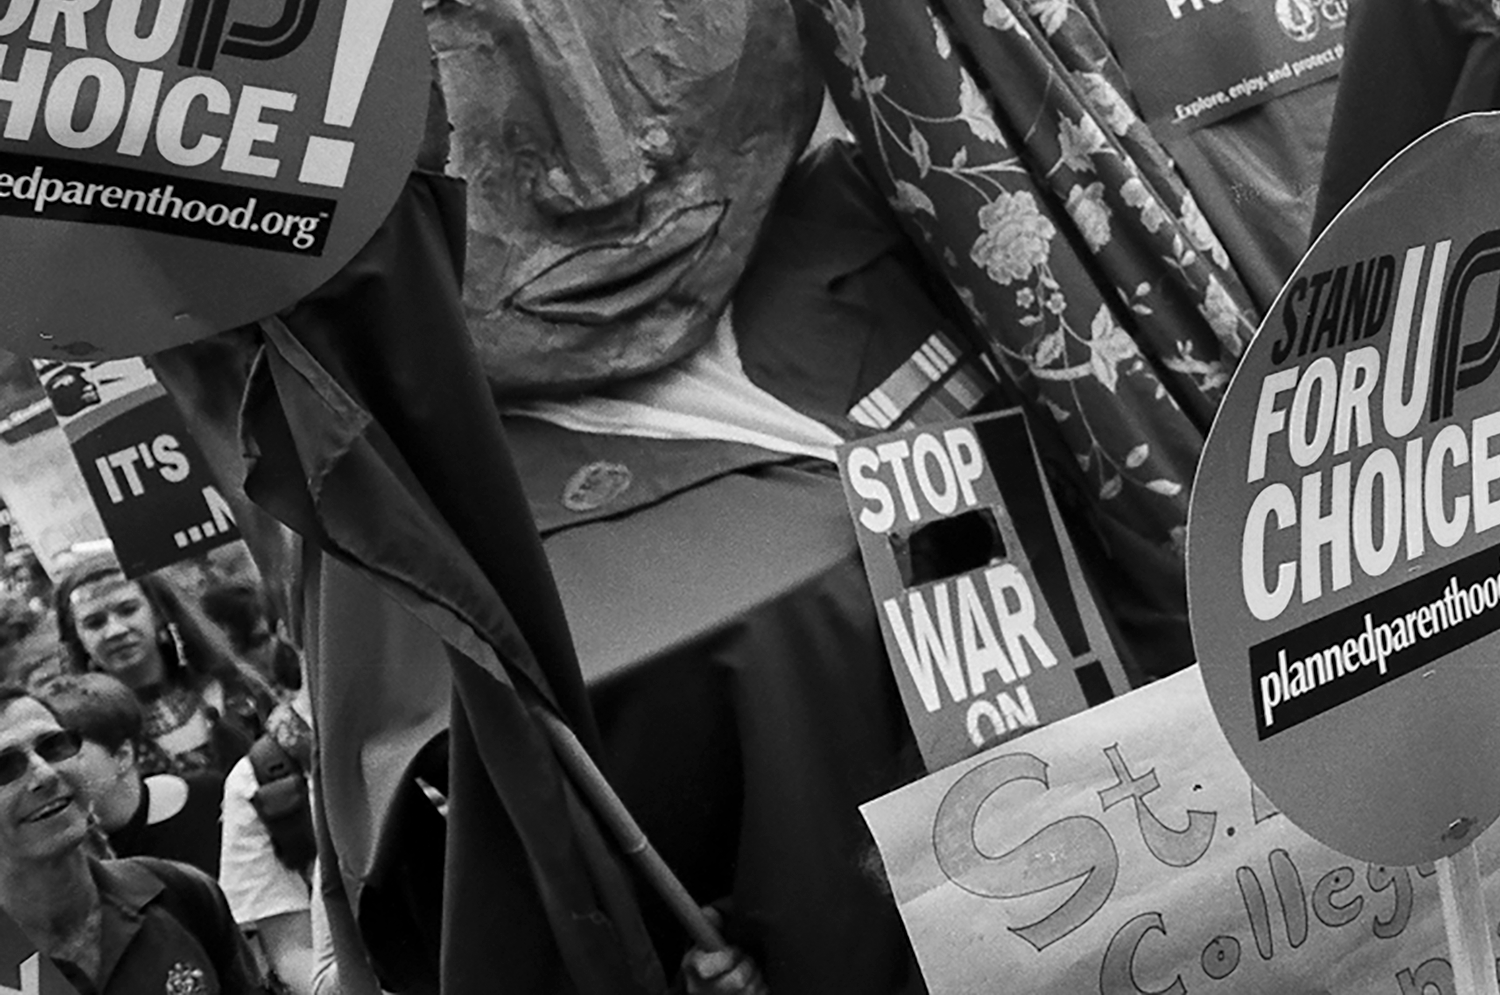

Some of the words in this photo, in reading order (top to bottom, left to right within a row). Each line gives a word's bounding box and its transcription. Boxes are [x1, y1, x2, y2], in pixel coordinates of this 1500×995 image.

[1174, 91, 1230, 120] Explore,
[1228, 75, 1268, 99] enjoy,
[1267, 61, 1292, 84] and
[1291, 48, 1336, 77] protect
[1271, 254, 1396, 365] STAND
[1247, 345, 1381, 484] FOR
[95, 434, 190, 504] IT'S
[847, 427, 984, 533] STOP
[883, 562, 1058, 713] WAR
[966, 684, 1041, 748] ON
